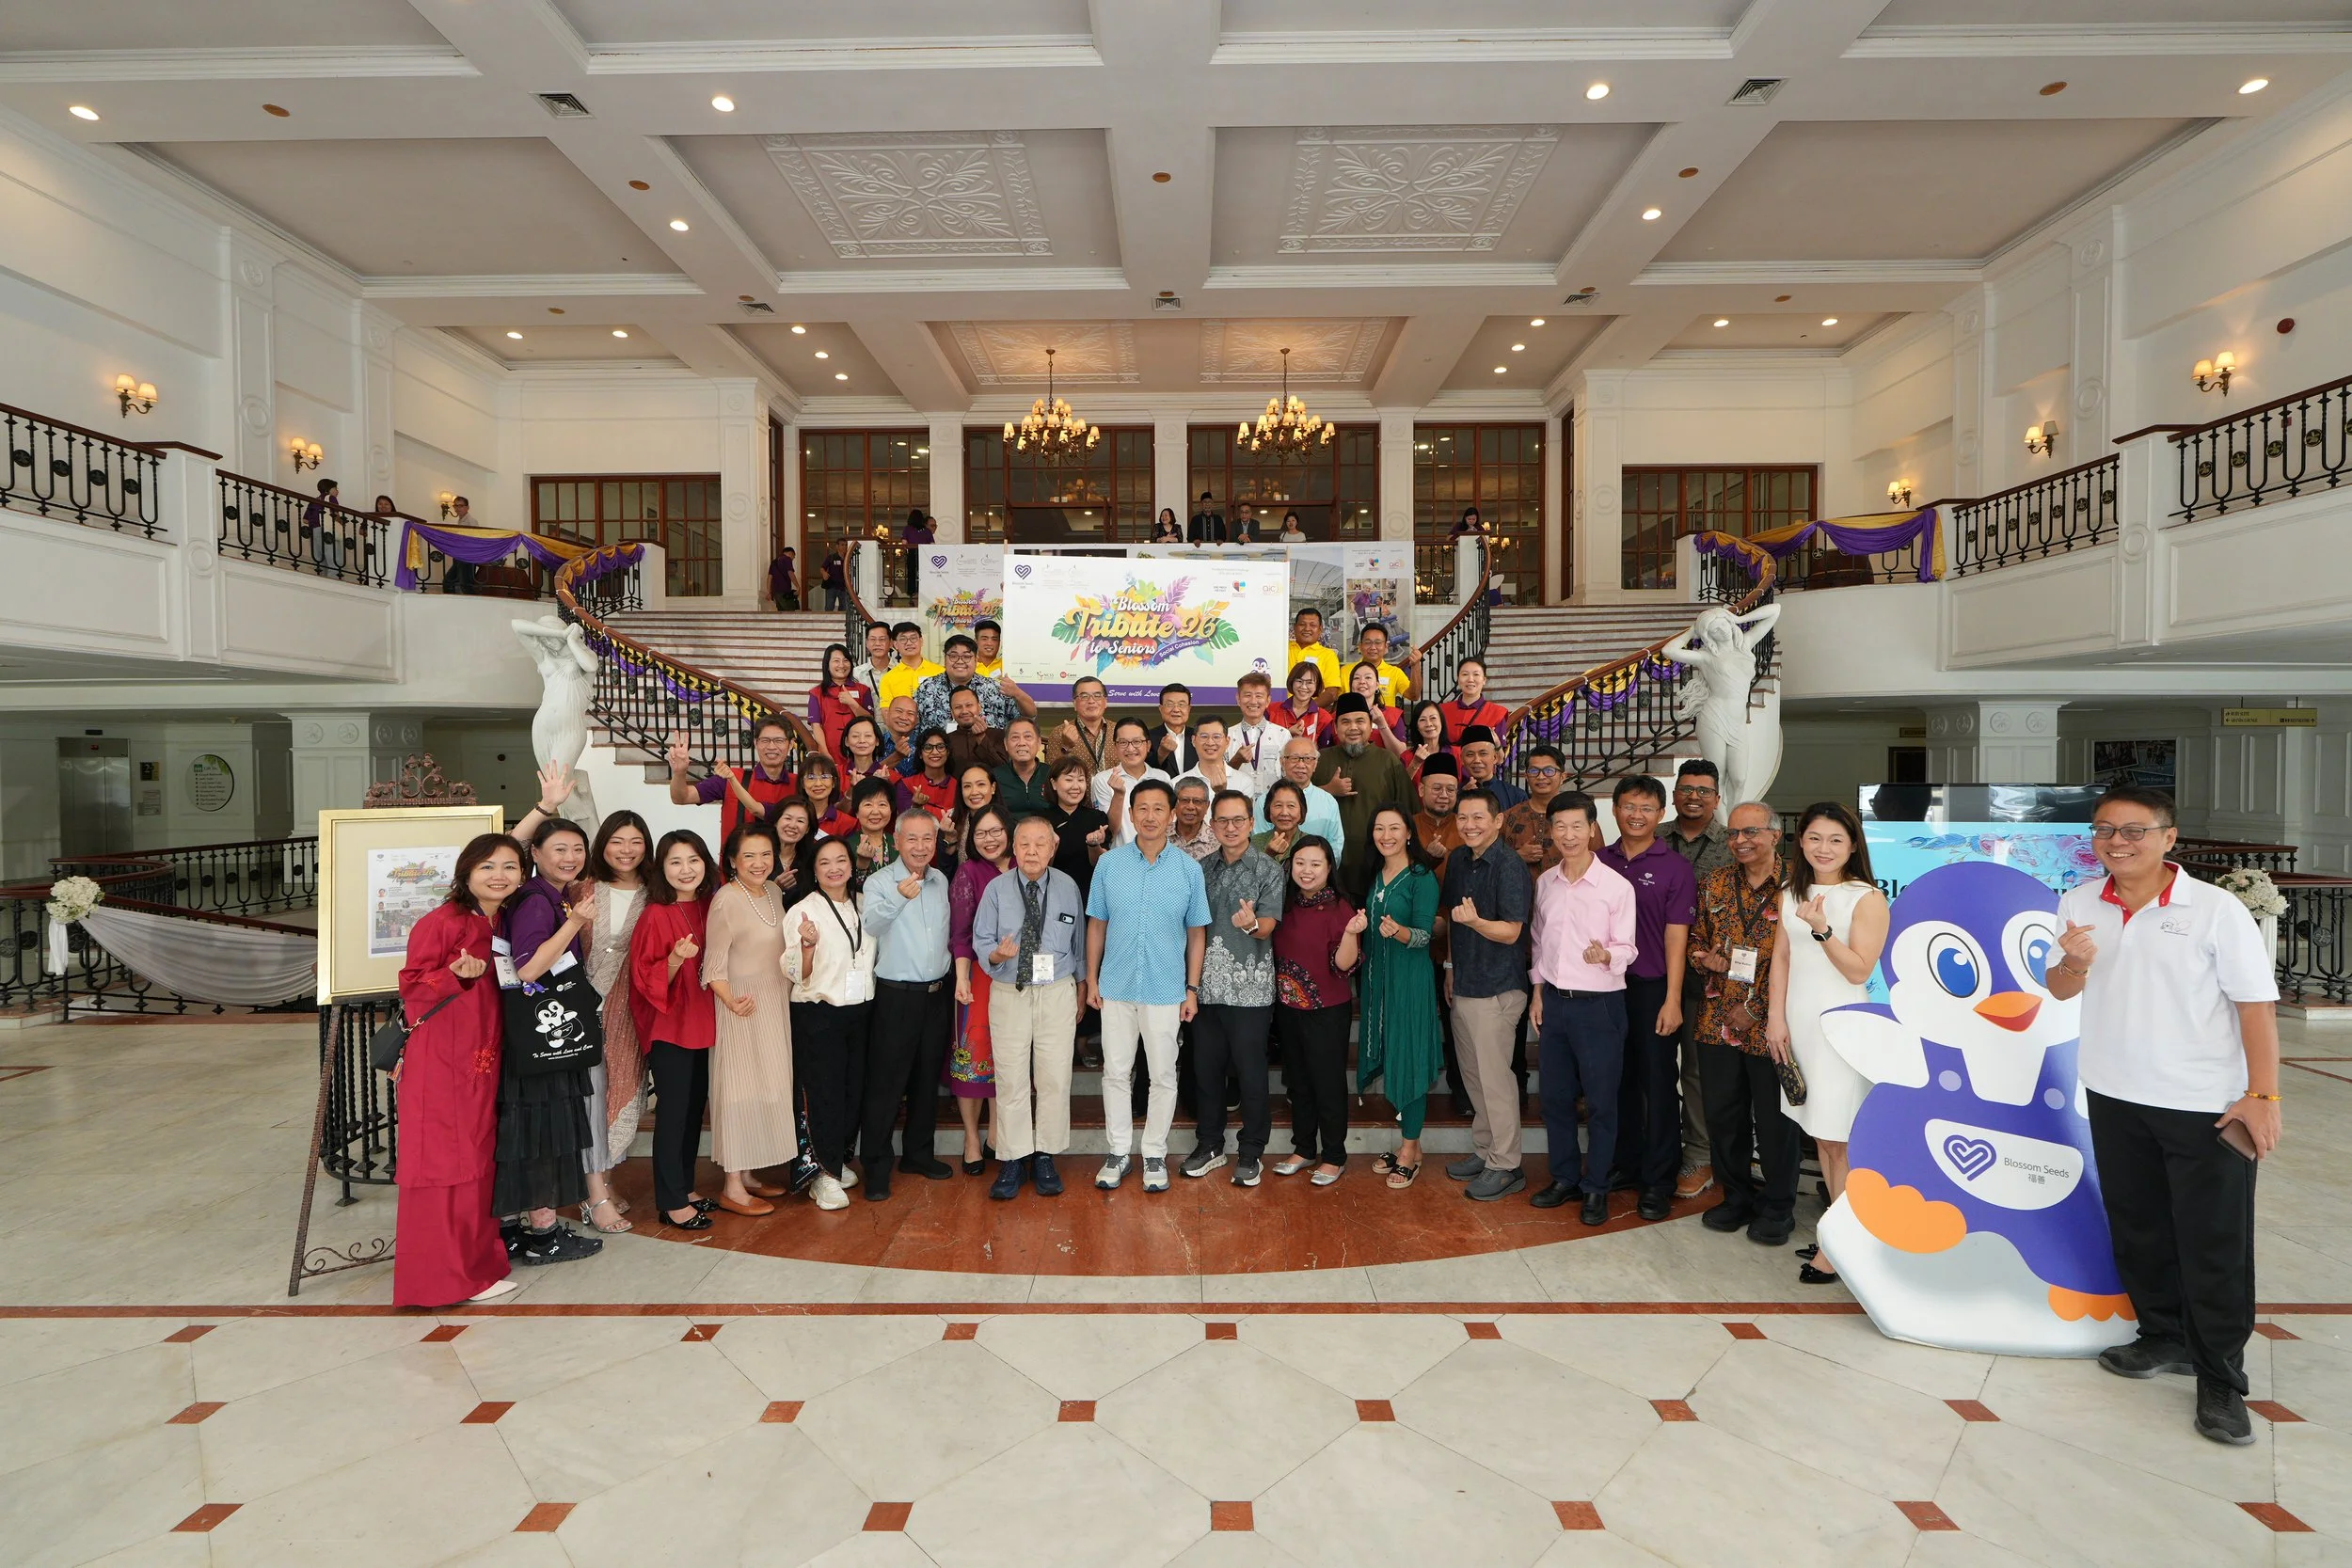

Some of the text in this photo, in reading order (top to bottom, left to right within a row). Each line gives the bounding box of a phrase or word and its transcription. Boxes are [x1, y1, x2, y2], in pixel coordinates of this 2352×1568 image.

[935, 605, 979, 616] Tribute
[1113, 596, 1170, 611] Blossom
[1065, 608, 1216, 638] Tribute 26
[1089, 641, 1155, 655] to Seniors
[1159, 640, 1200, 657] Social Cohesion
[2004, 1157, 2070, 1179] Blossom Seeds
